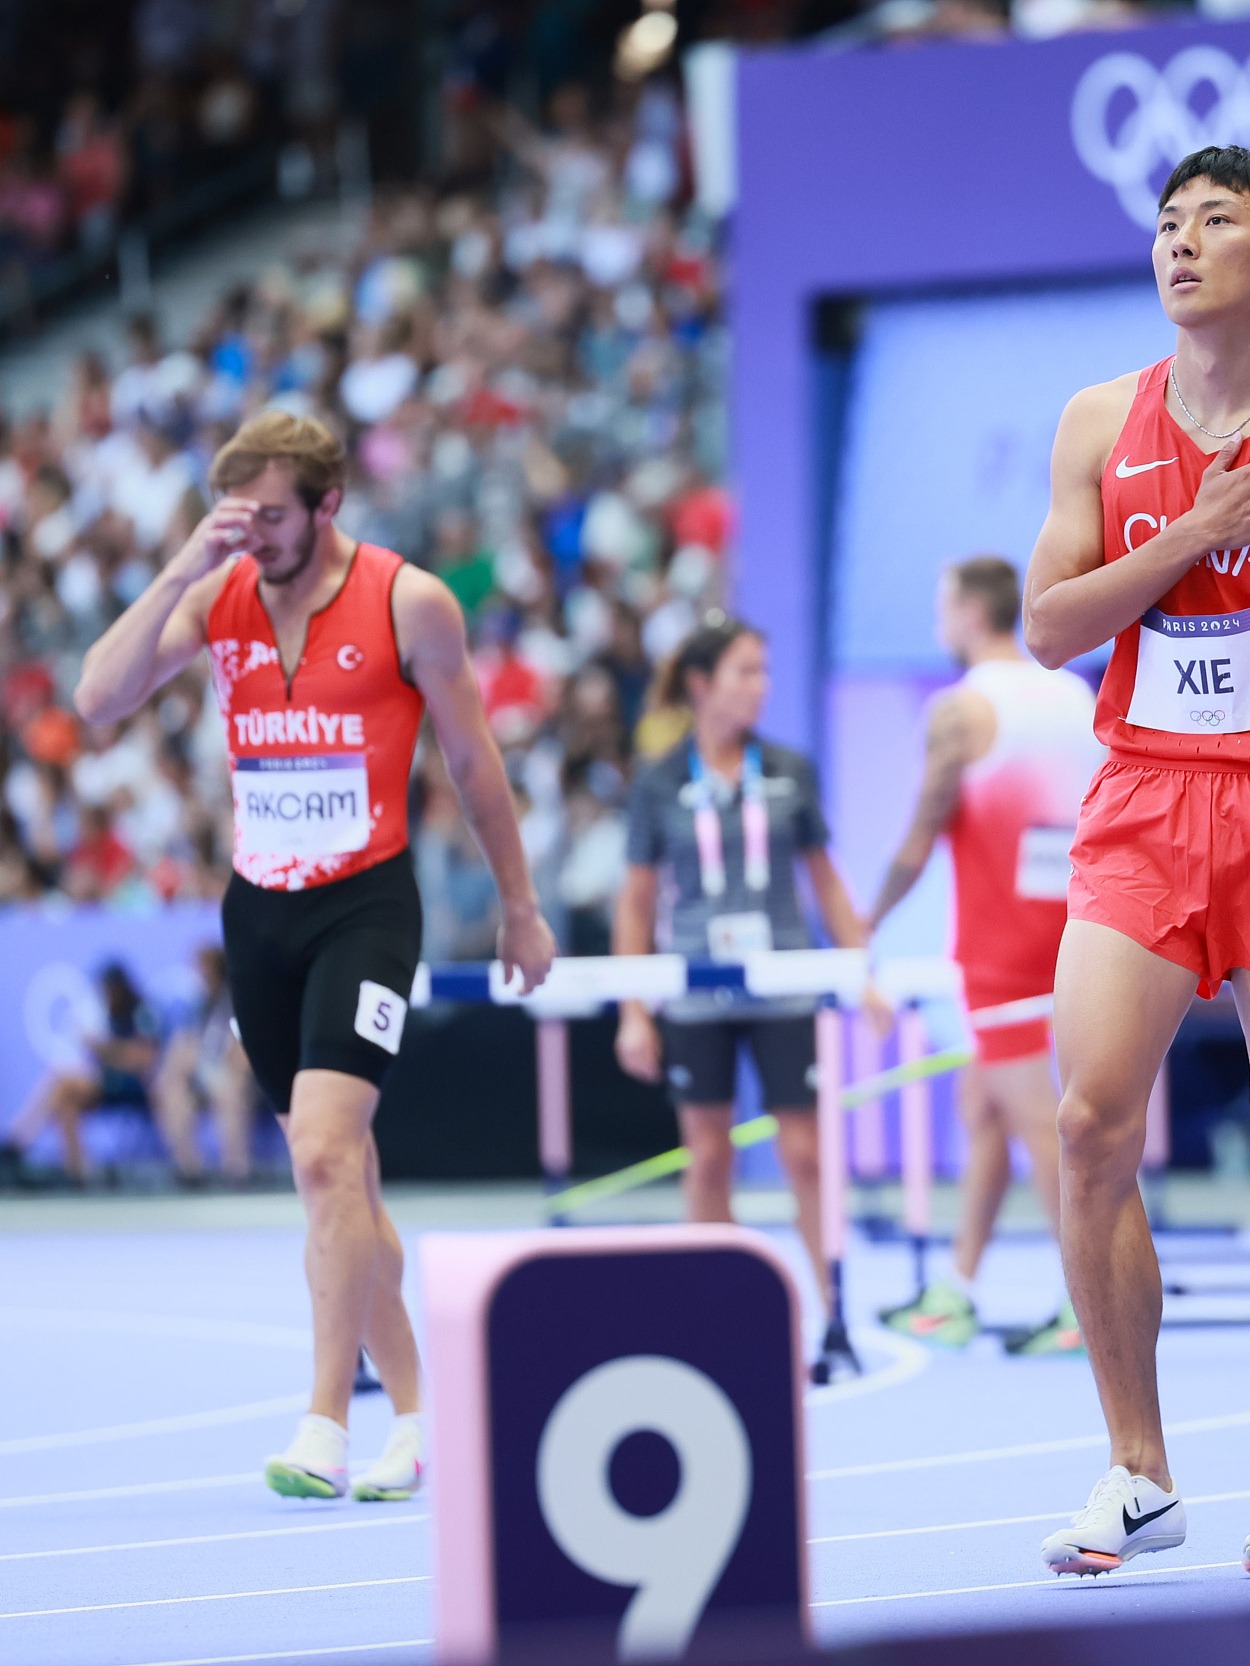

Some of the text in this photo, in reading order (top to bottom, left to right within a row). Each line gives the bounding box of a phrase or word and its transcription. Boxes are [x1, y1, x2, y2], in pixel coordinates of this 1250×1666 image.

[1162, 618, 1240, 632] PARIS 2024
[1174, 659, 1234, 694] XIE
[373, 1001, 391, 1031] 5
[537, 1354, 752, 1663] 9
